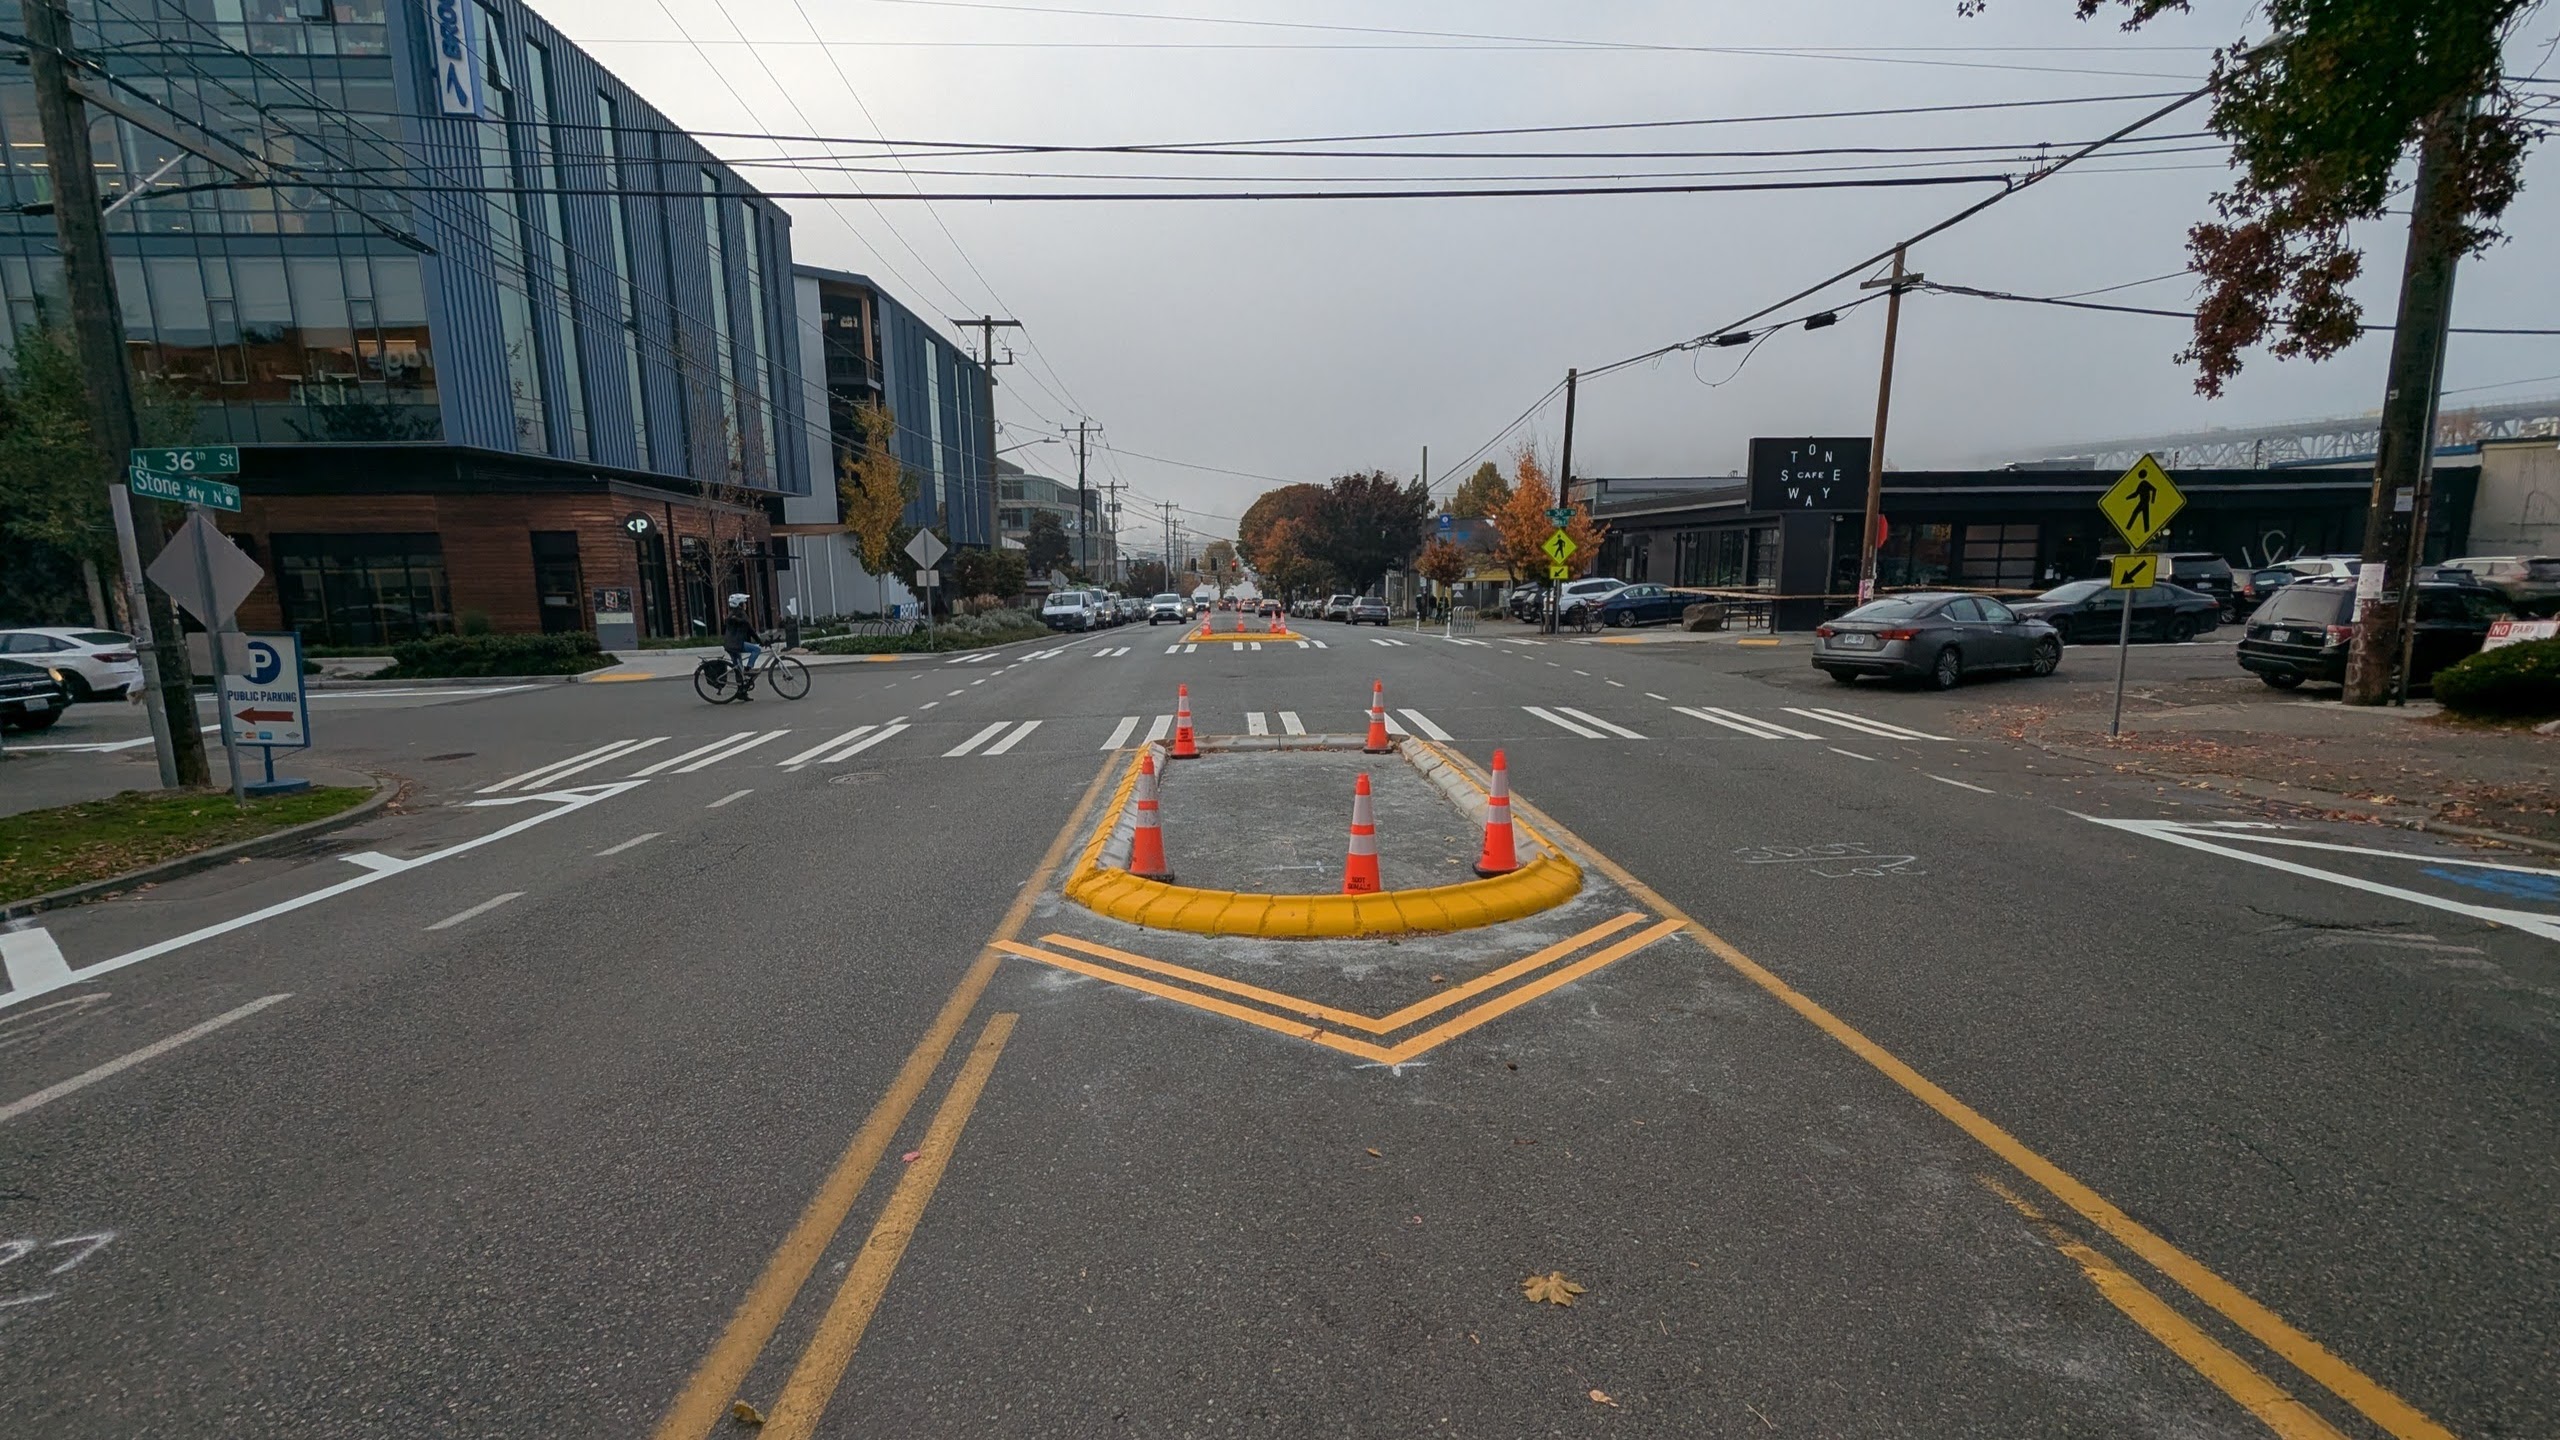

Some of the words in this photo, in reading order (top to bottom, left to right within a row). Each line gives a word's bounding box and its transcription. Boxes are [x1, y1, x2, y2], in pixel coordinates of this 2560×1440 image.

[137, 455, 148, 468] N
[165, 451, 206, 471] 36th
[219, 453, 234, 467] St
[1797, 471, 1825, 479] CAFE
[135, 470, 181, 496] Stone
[187, 485, 205, 503] Wy
[213, 490, 223, 503] N
[1788, 487, 1831, 507] WAY
[636, 519, 648, 533] P
[2492, 624, 2509, 636] NO
[248, 649, 273, 678] P
[227, 690, 259, 702] PUBLIC
[261, 691, 297, 703] PARKING
